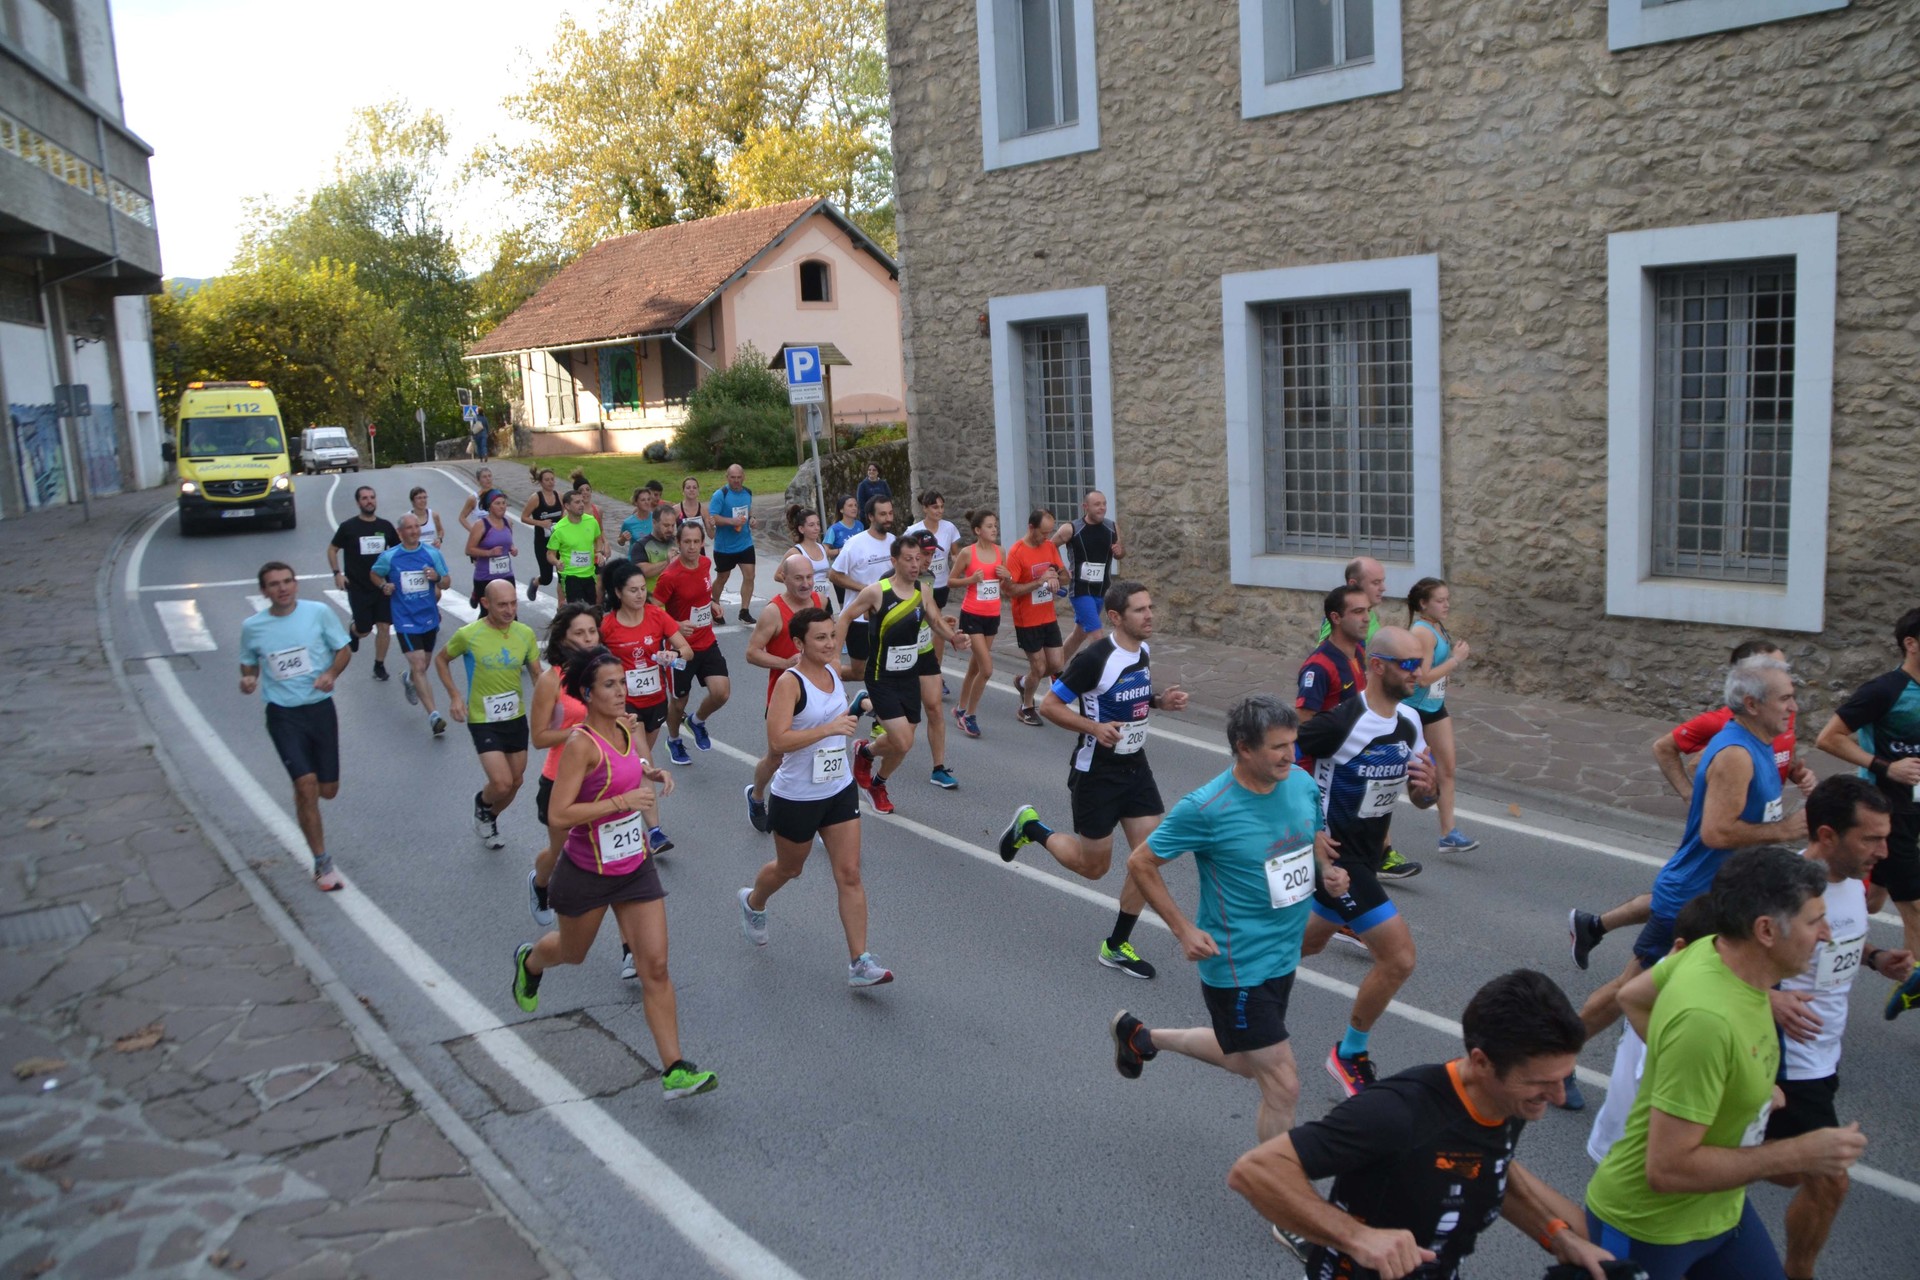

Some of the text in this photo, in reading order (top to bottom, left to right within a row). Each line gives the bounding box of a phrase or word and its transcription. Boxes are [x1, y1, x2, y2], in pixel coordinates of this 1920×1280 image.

[791, 351, 814, 381] P
[234, 403, 260, 413] 112
[1086, 568, 1101, 576] 217
[408, 577, 425, 586] 199
[983, 586, 997, 595] 263
[697, 611, 711, 622] 239
[278, 656, 303, 672] 246
[895, 653, 912, 664] 250
[635, 676, 655, 689] 241
[1115, 685, 1150, 702] ERREKA
[493, 701, 514, 714] 242
[1127, 731, 1144, 745] 208
[823, 757, 843, 773] 237
[1358, 764, 1404, 777] ERREKA
[1373, 791, 1397, 807] 222
[613, 827, 641, 849] 213
[1283, 865, 1310, 891] 202
[1833, 948, 1860, 973] 223
